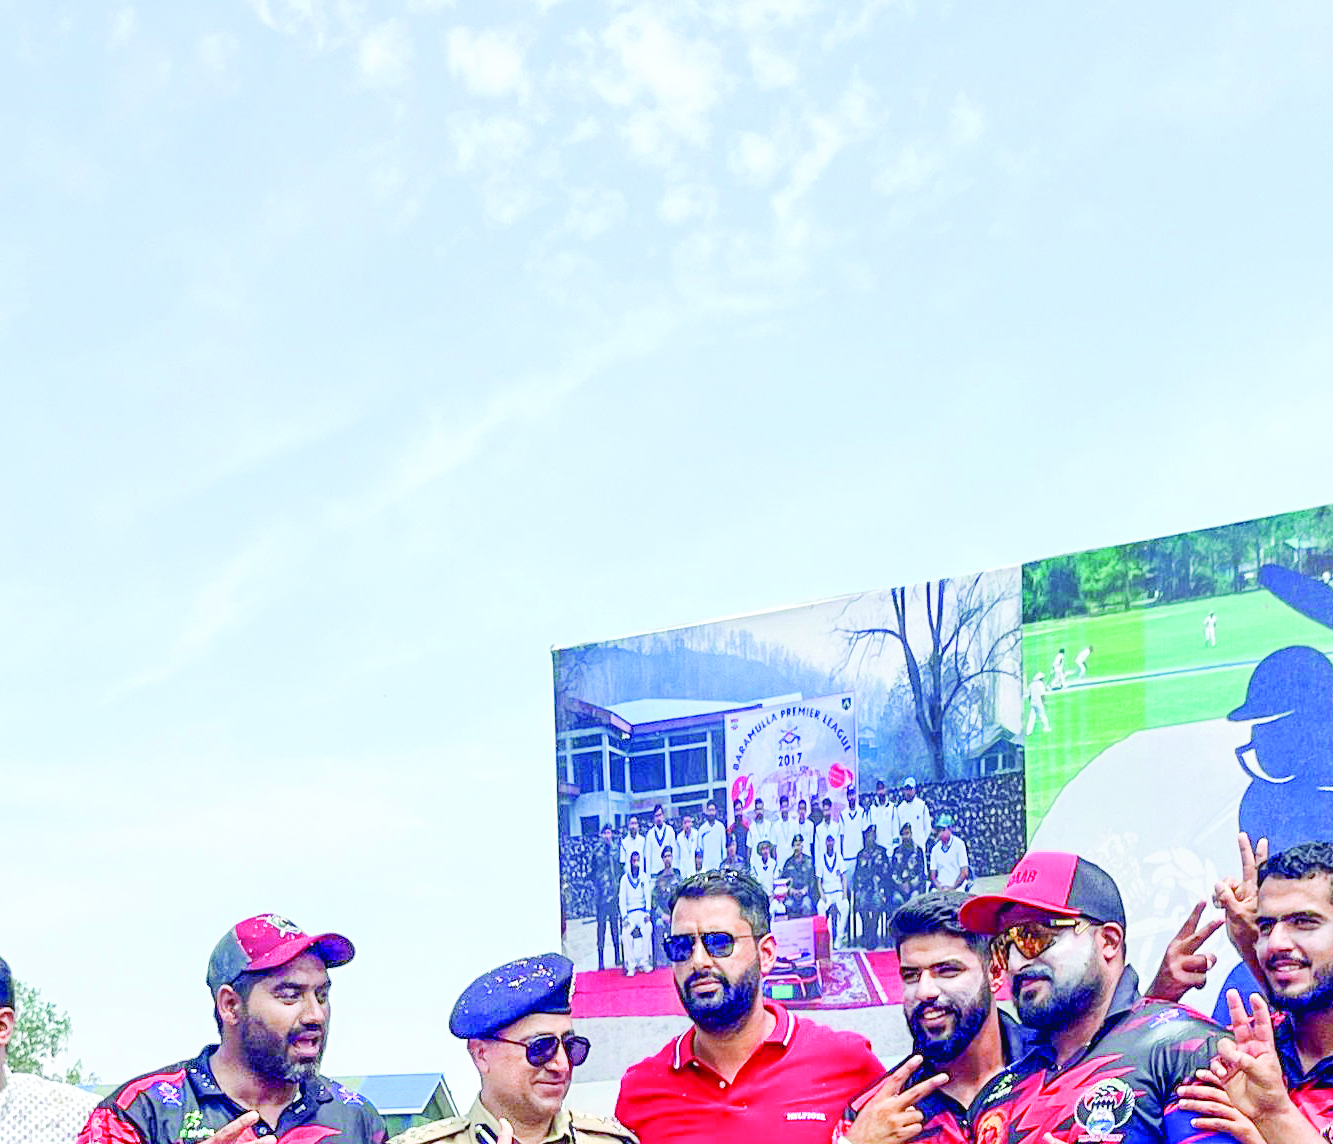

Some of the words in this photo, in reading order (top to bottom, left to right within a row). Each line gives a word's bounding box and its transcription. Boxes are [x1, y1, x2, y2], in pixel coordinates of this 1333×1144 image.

[733, 713, 778, 771] BARAMULLA
[780, 707, 821, 722] PREMIER
[823, 715, 852, 753] LEAGUE
[778, 752, 803, 767] 2017
